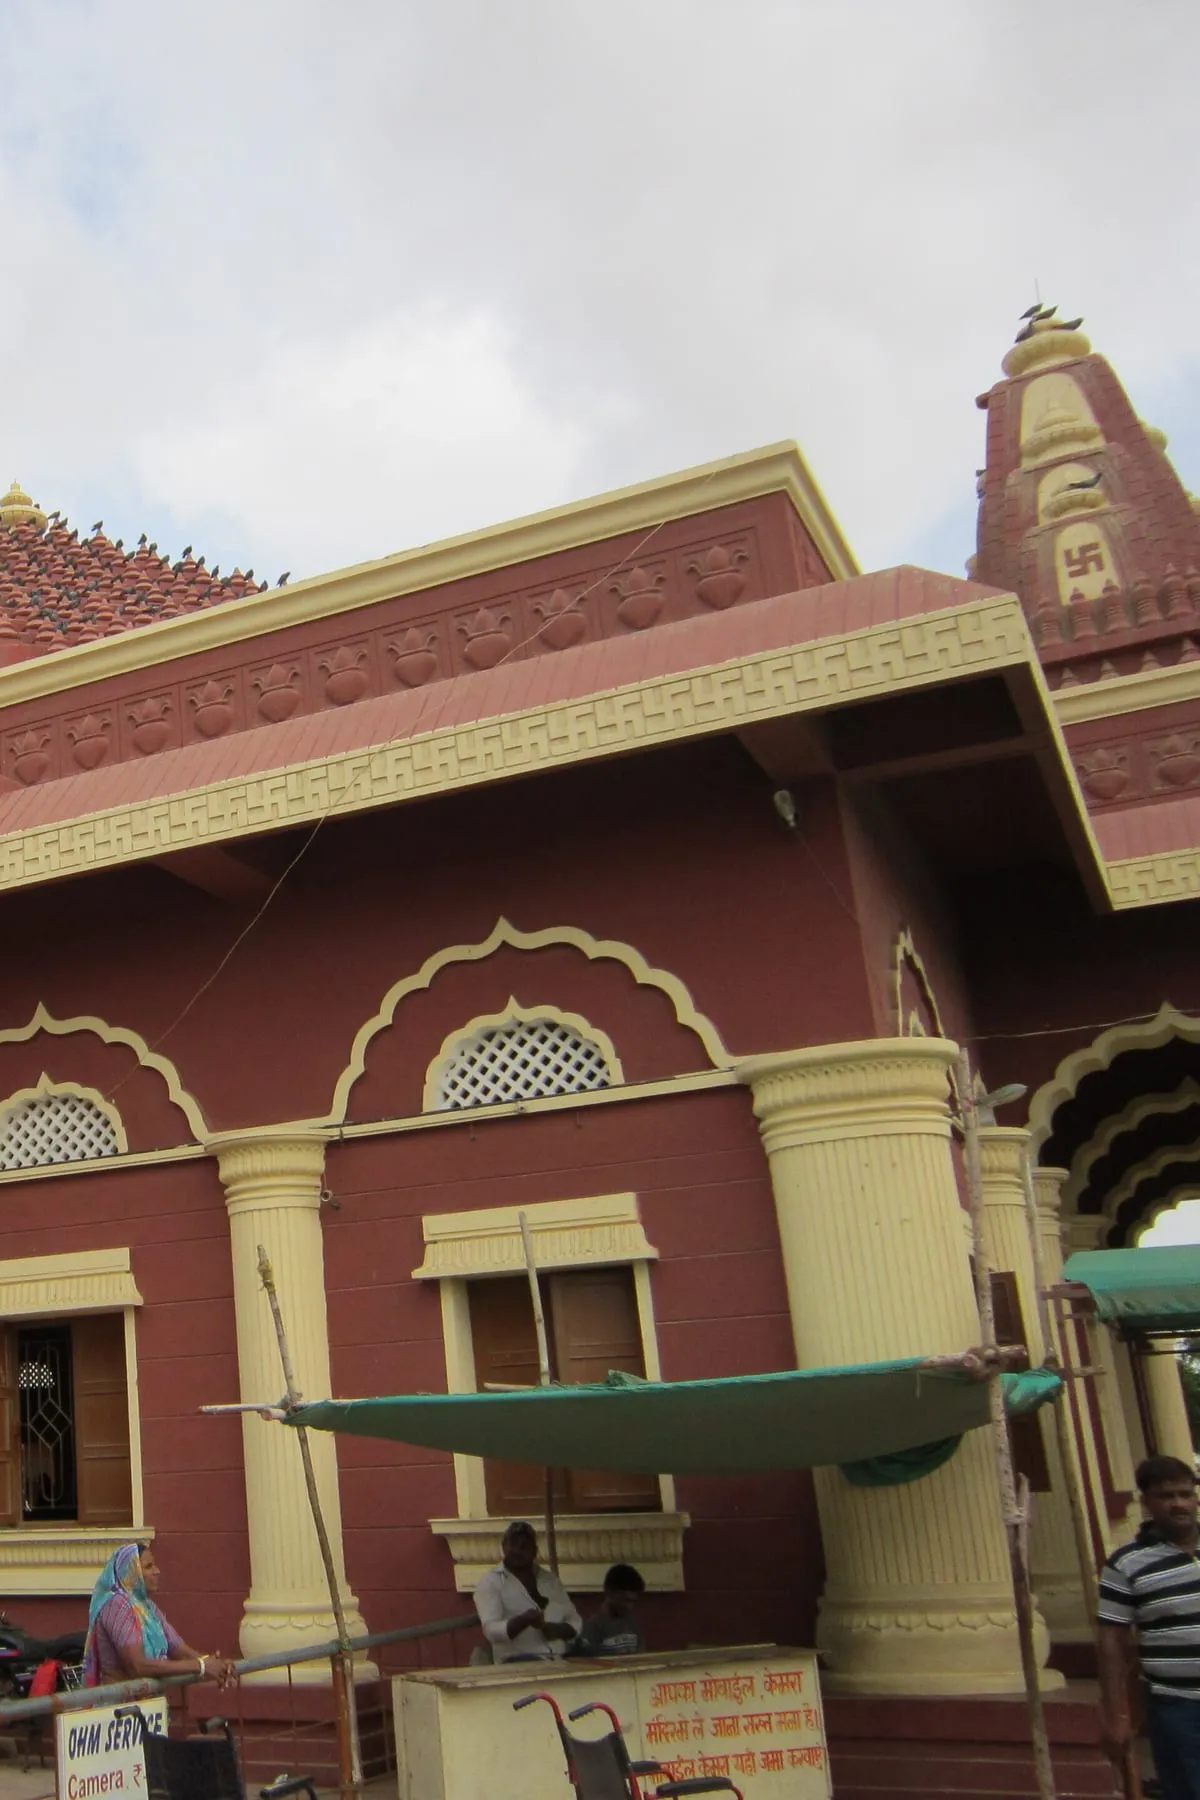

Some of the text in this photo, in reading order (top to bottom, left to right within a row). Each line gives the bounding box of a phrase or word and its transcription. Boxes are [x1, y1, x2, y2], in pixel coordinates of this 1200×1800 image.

[69, 1712, 163, 1760] OHM SERVCE
[68, 1769, 123, 1800] Camera
